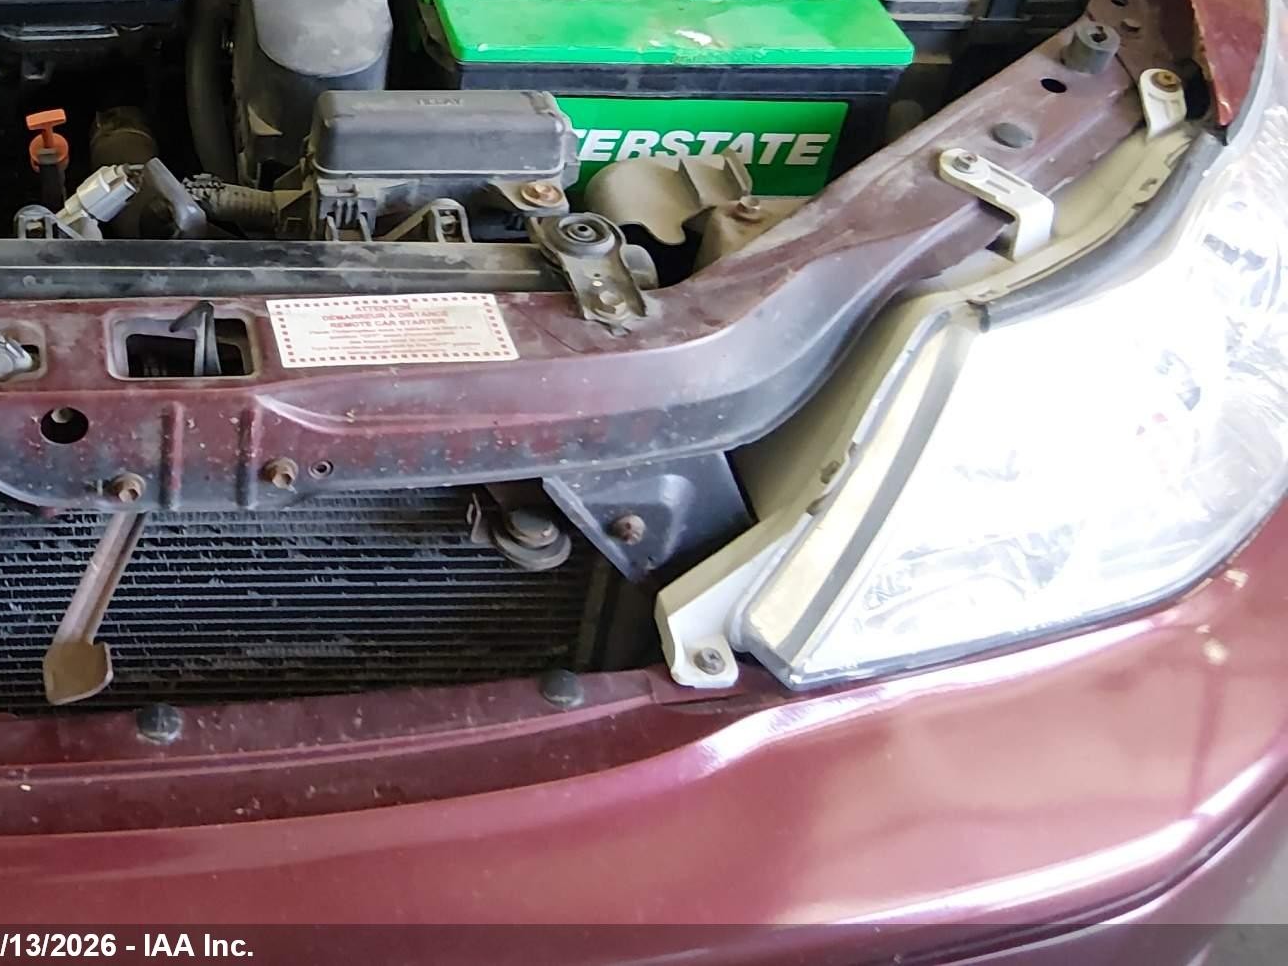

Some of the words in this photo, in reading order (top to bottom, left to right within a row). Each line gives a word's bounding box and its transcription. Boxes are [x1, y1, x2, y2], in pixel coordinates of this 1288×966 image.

[398, 310, 449, 319] DISTANCE
[330, 321, 373, 329] REMOTE
[375, 319, 397, 327] CAR
[399, 318, 446, 326] STARTER
